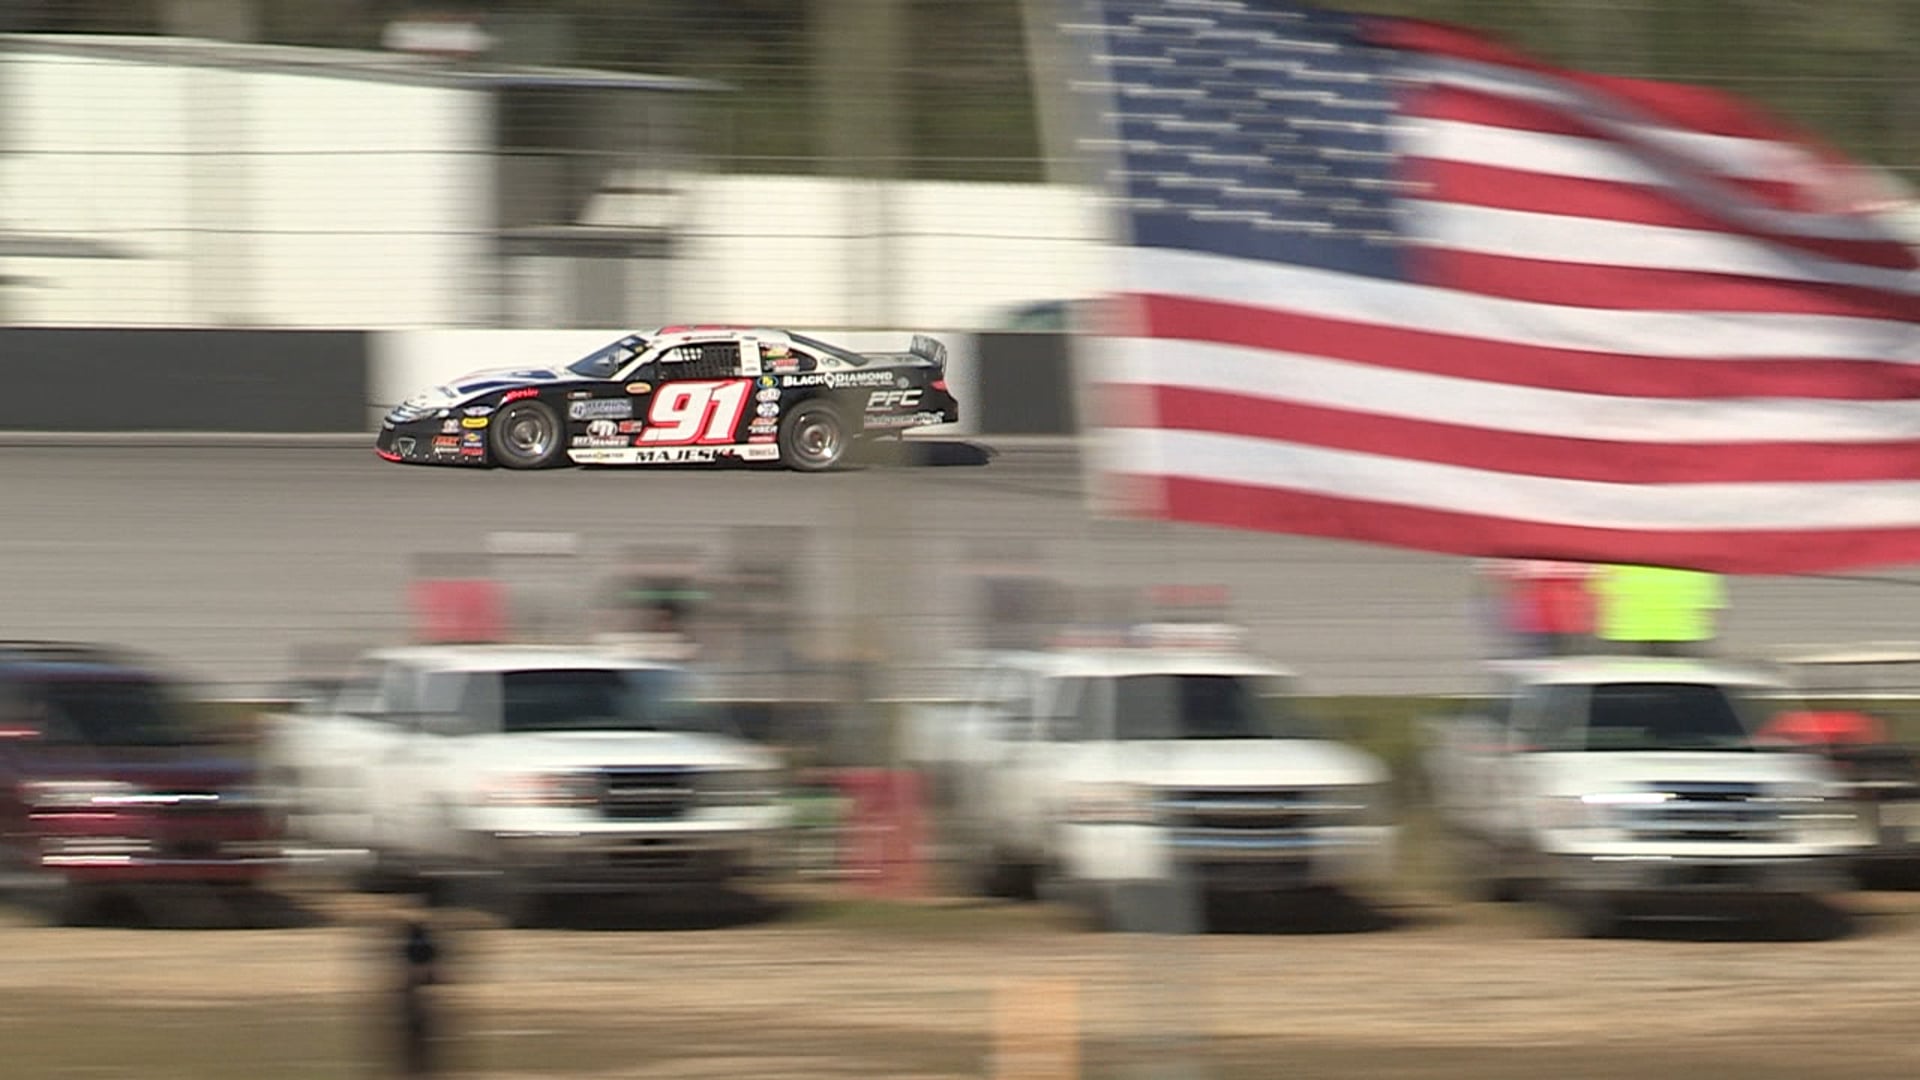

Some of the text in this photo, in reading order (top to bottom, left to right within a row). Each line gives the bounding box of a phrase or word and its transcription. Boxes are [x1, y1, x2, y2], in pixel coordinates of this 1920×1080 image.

[783, 375, 824, 387] BLACK
[835, 372, 893, 382] DIAMOND
[868, 390, 923, 406] PFC
[636, 379, 752, 446] 91
